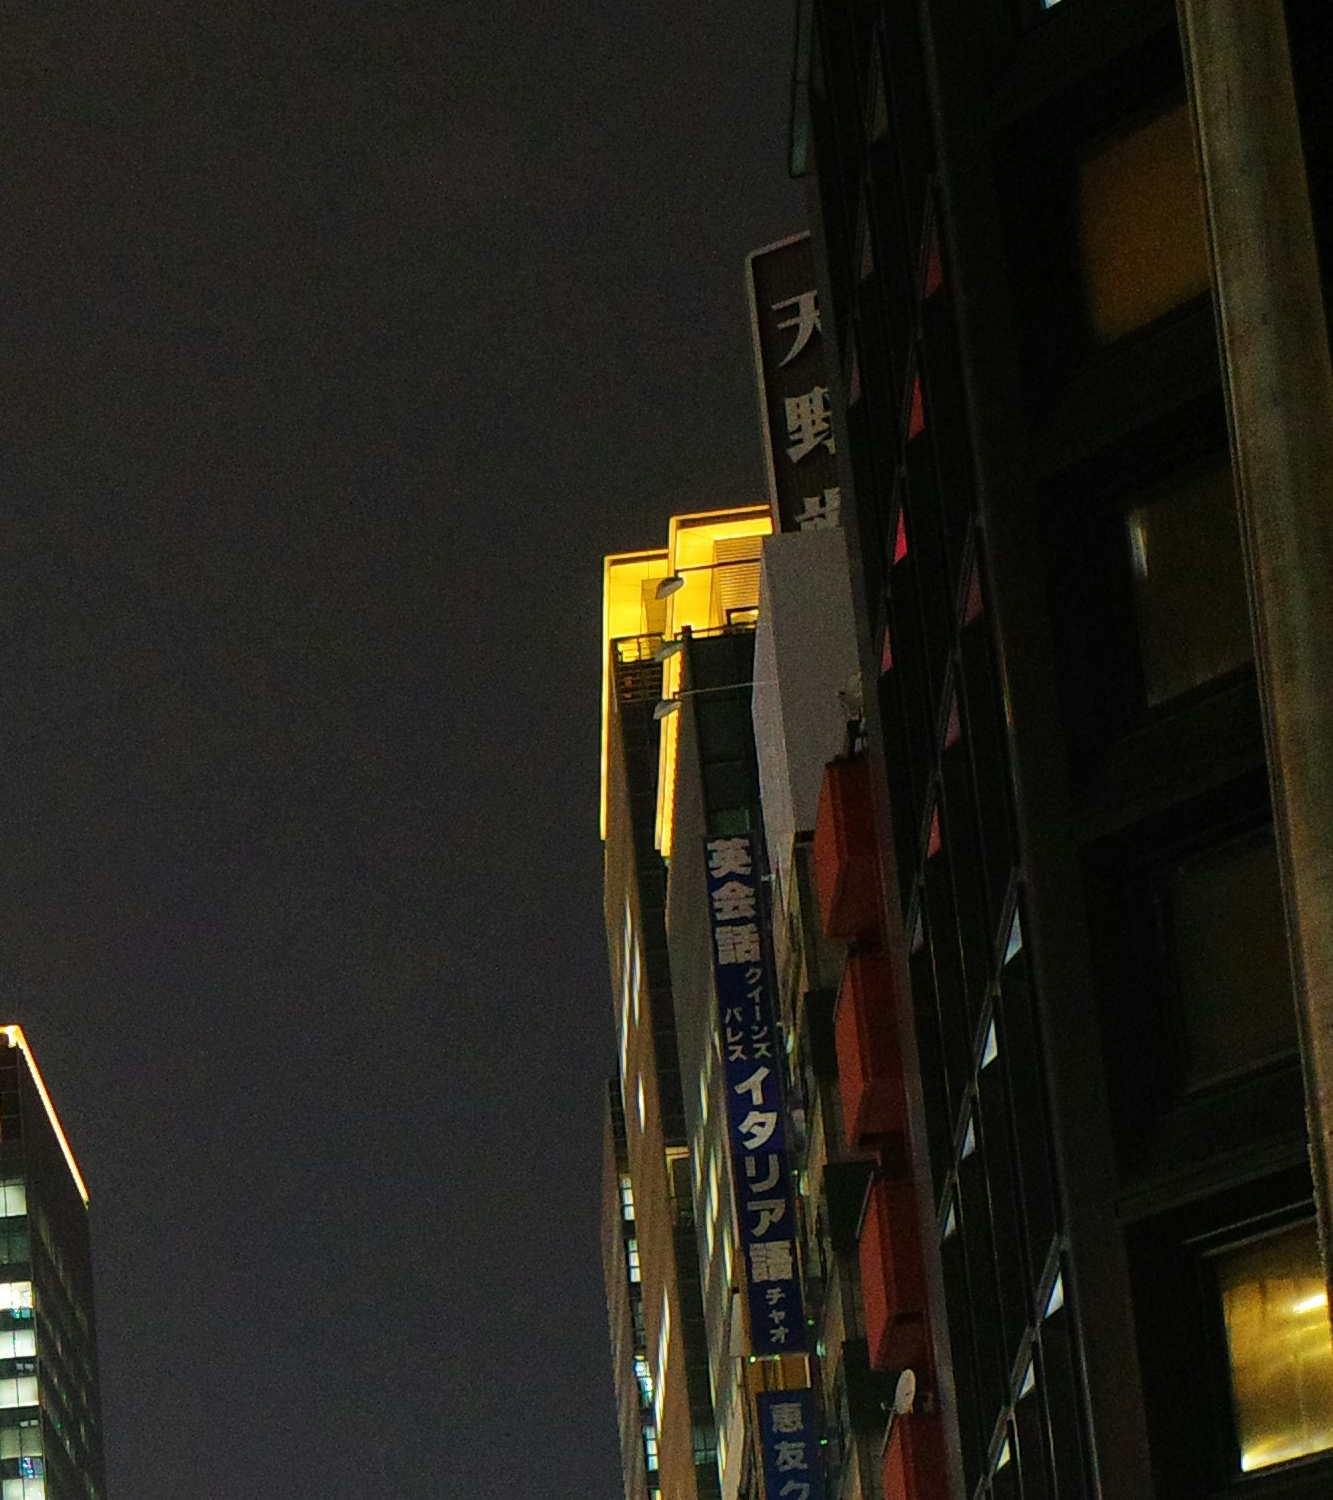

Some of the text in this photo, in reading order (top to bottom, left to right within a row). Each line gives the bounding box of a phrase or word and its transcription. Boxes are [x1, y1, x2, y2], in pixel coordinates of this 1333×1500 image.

[707, 836, 761, 966] 英会話
[733, 1065, 794, 1284] イタリア語
[764, 1287, 790, 1344] チャオ
